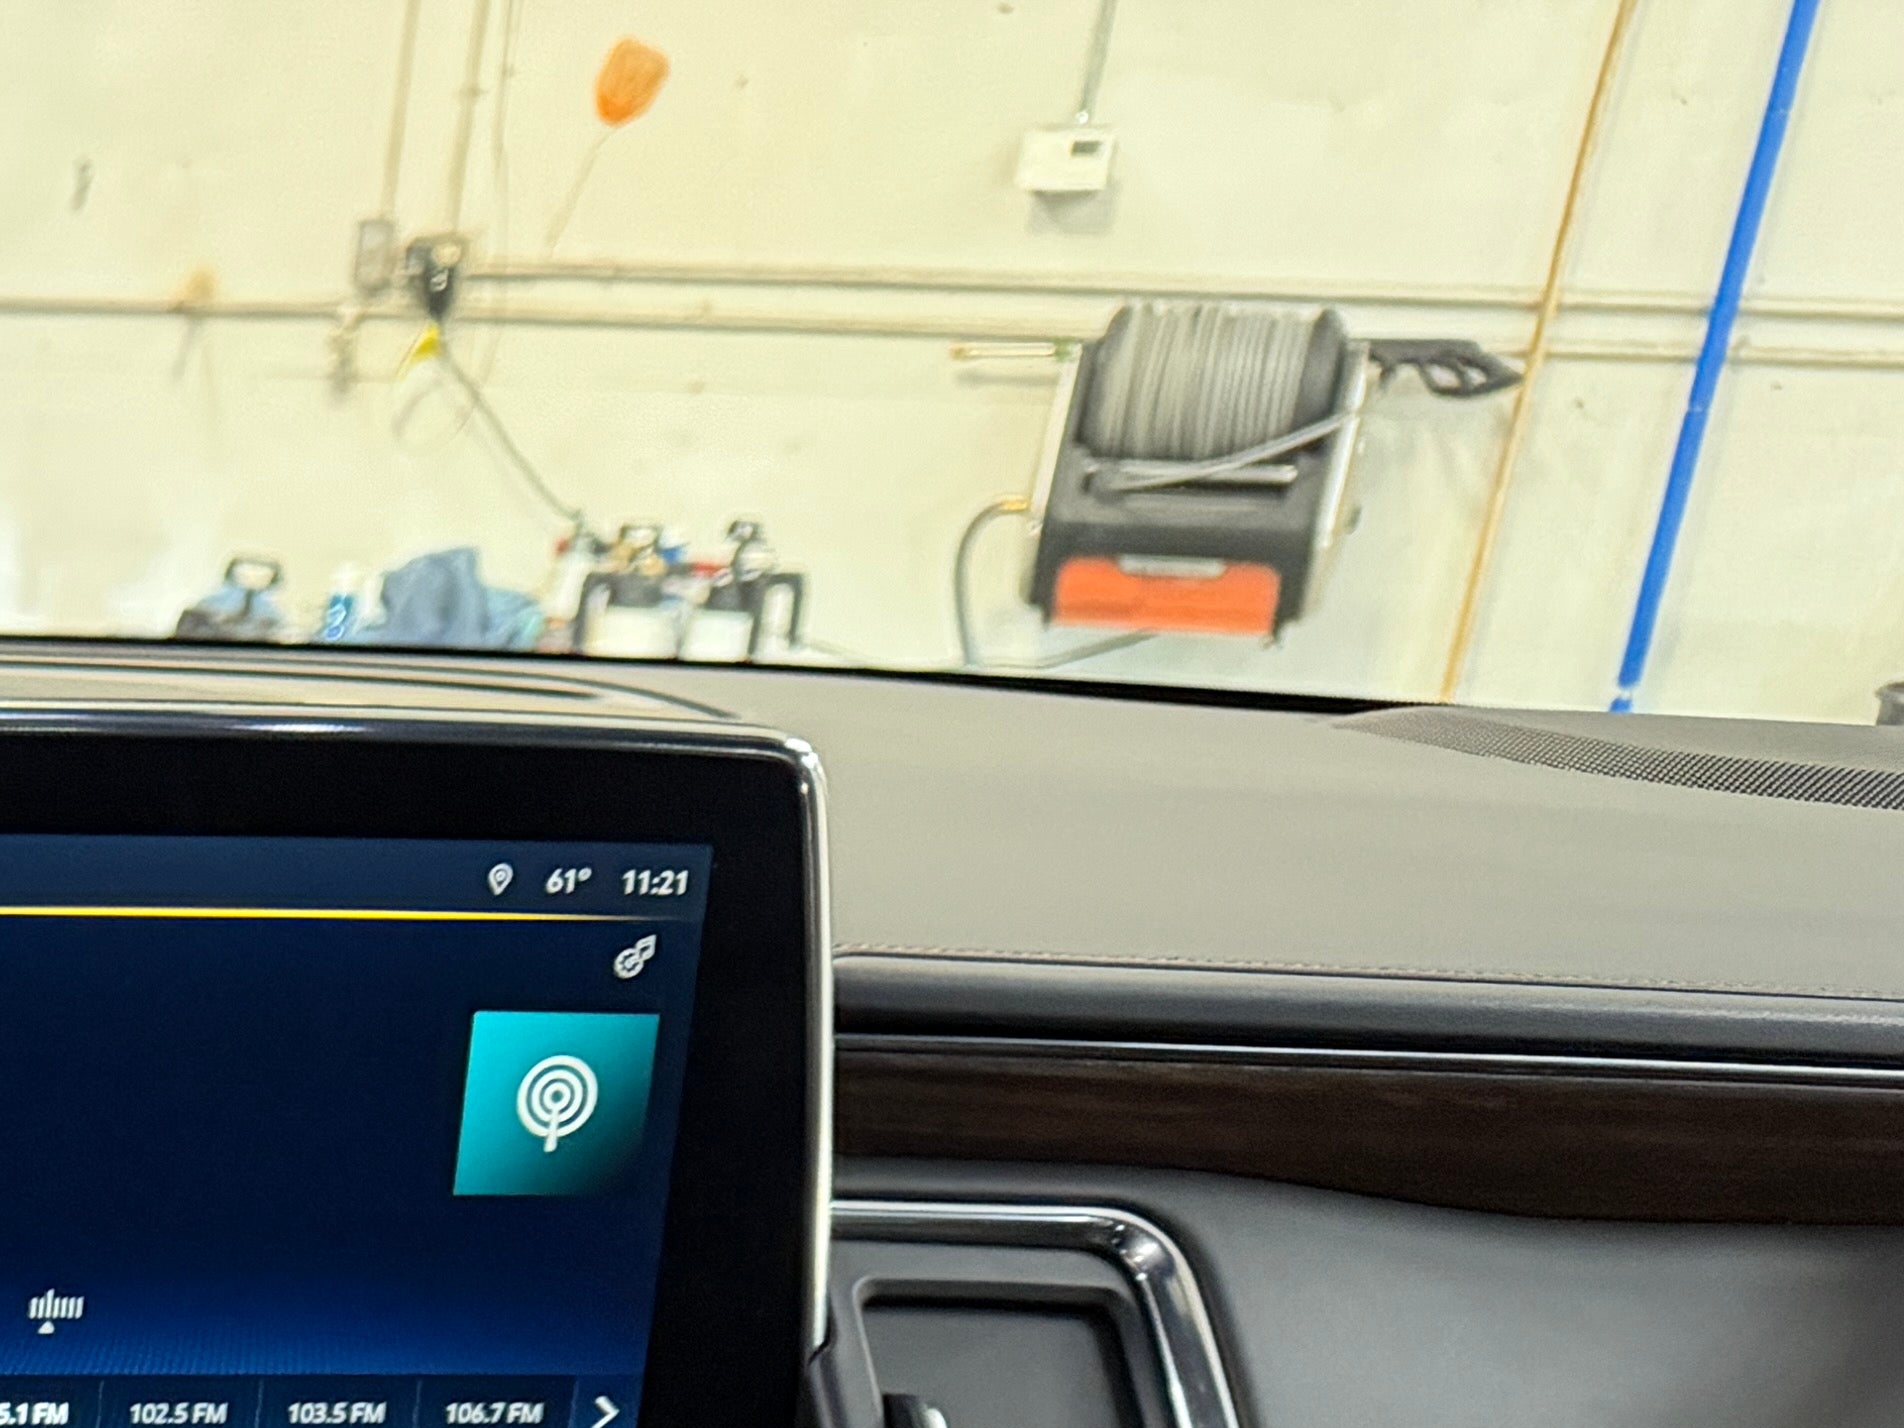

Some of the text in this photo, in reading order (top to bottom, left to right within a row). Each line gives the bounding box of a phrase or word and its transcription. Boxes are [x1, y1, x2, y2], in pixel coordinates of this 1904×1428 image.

[545, 868, 592, 894] 61°
[621, 868, 689, 896] 11:21
[30, 1402, 69, 1426] FM
[129, 1402, 227, 1426] 102.5 FM
[288, 1402, 386, 1426] 103.5 FM
[445, 1402, 544, 1426] 106.7 FM
